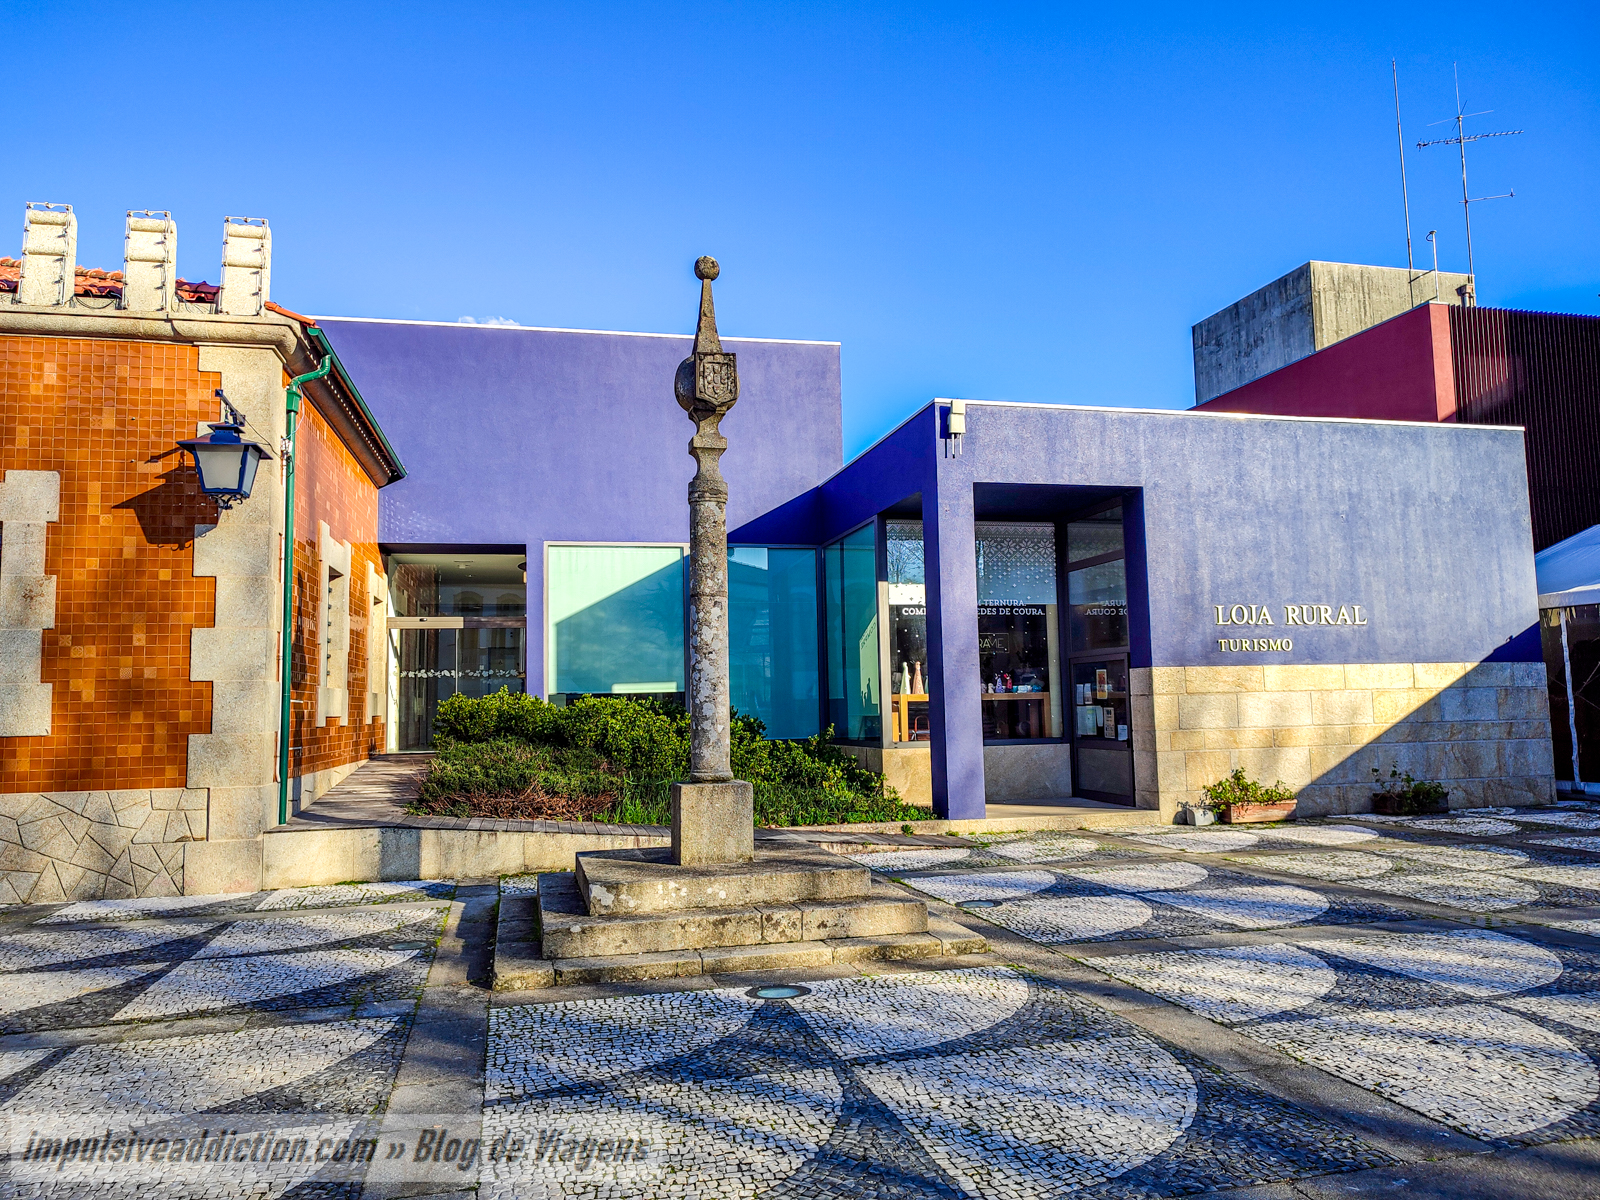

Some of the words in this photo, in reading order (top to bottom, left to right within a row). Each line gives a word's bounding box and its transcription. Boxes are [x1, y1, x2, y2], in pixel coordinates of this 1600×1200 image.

[983, 599, 1027, 607] TERNURA.
[999, 607, 1011, 616] DE
[1012, 607, 1046, 616] COURA.
[1215, 604, 1275, 626] LOJA
[1284, 604, 1368, 626] RURAL
[1217, 638, 1294, 652] TURISMO
